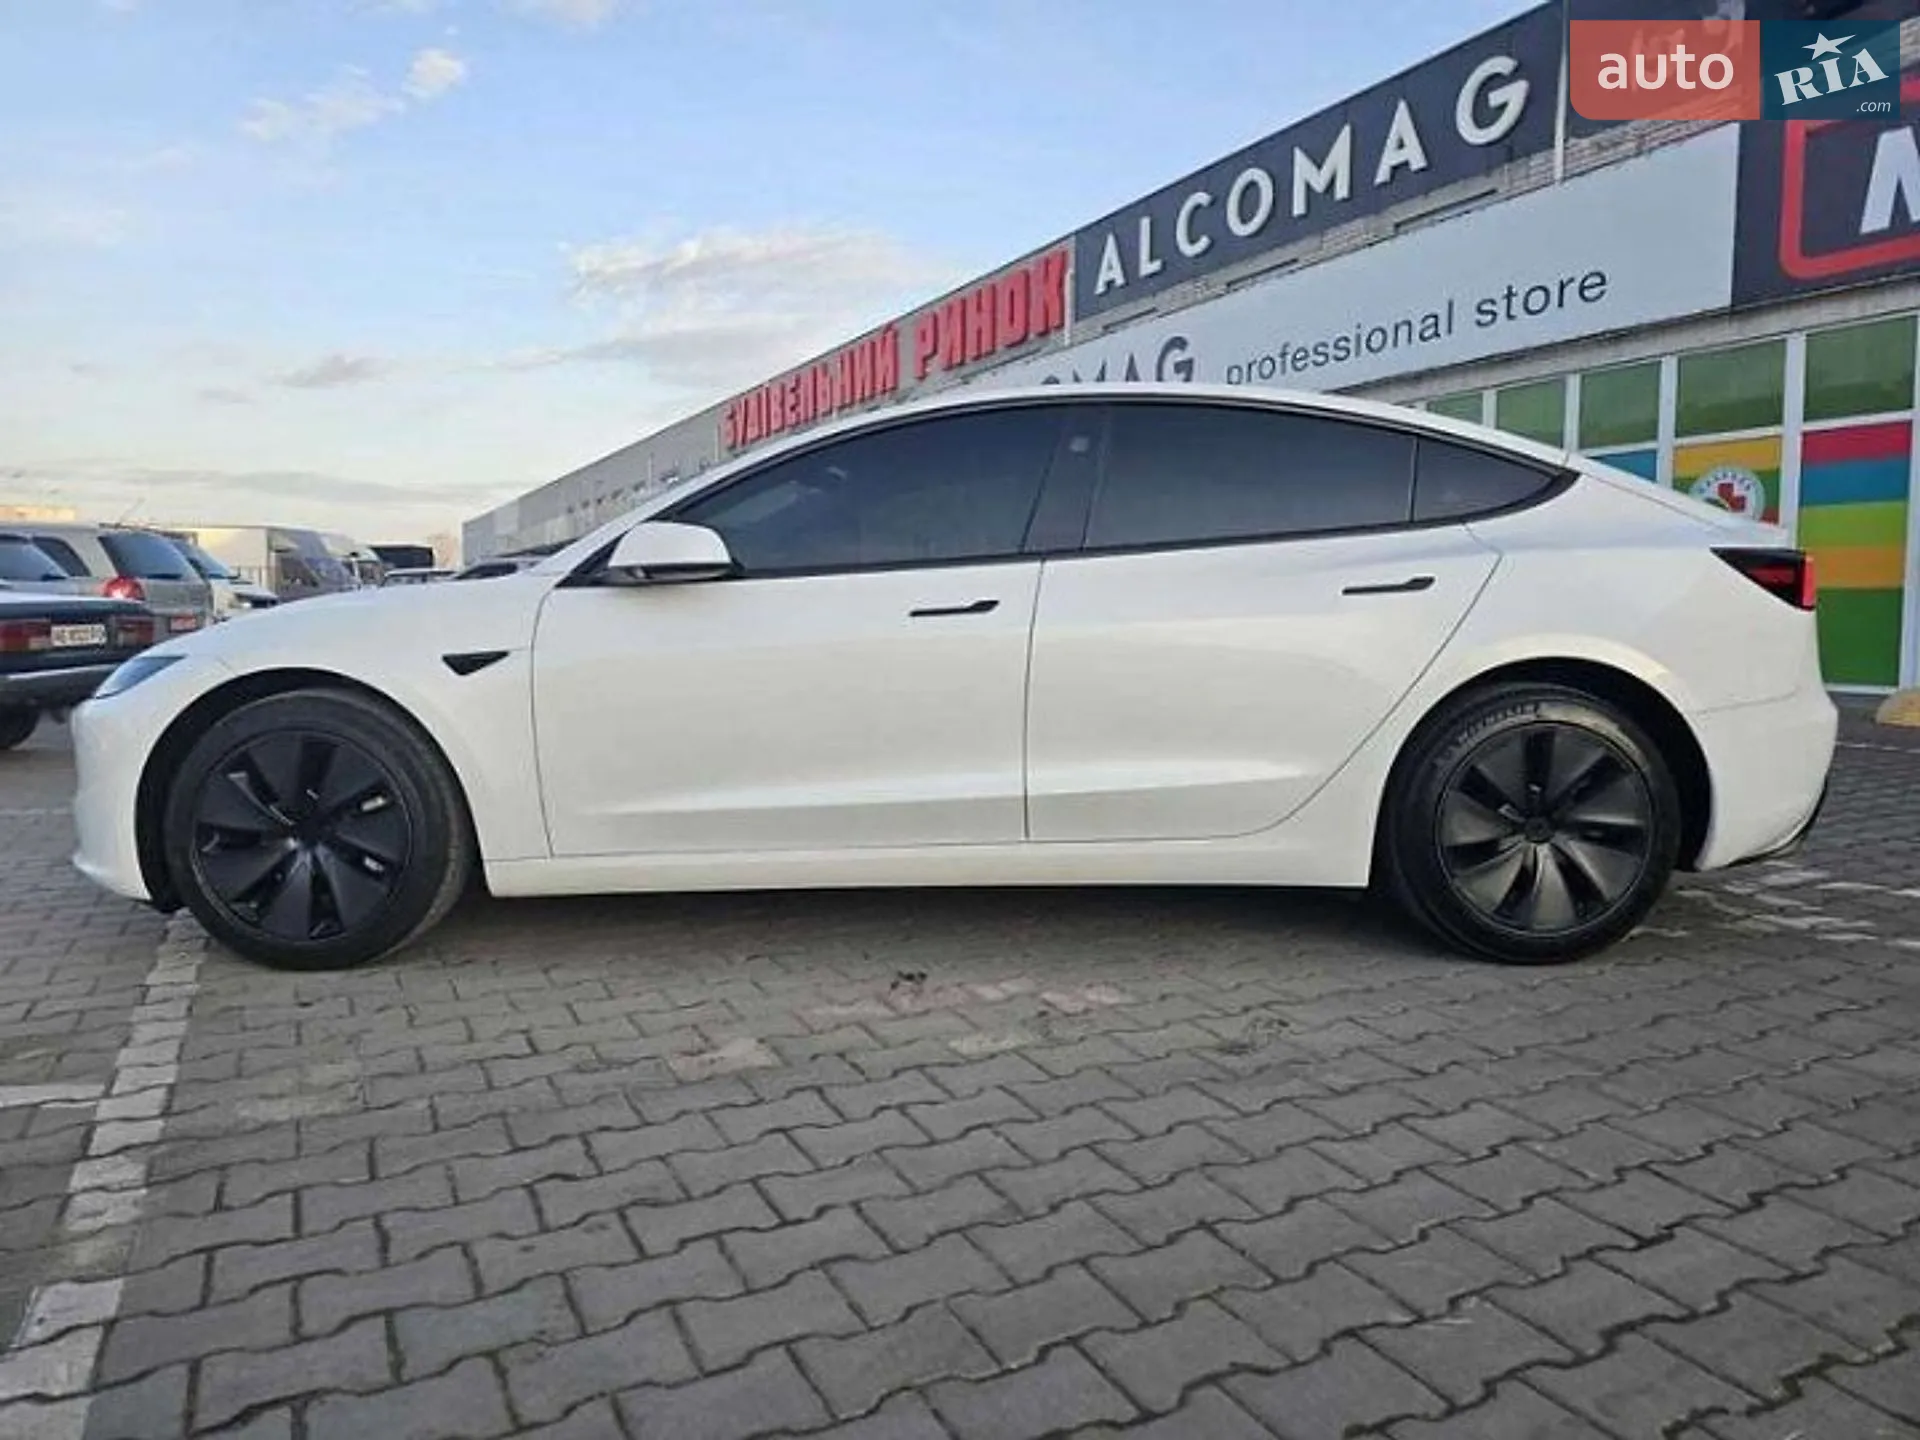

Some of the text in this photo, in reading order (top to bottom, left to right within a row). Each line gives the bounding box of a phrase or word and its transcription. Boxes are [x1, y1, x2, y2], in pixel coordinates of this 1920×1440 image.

[1094, 55, 1530, 295] ALCOMAG
[722, 243, 1069, 449] БУДІВЕЛЬНИЙ РИНОК
[1226, 300, 1454, 386] professional
[1475, 269, 1608, 328] store
